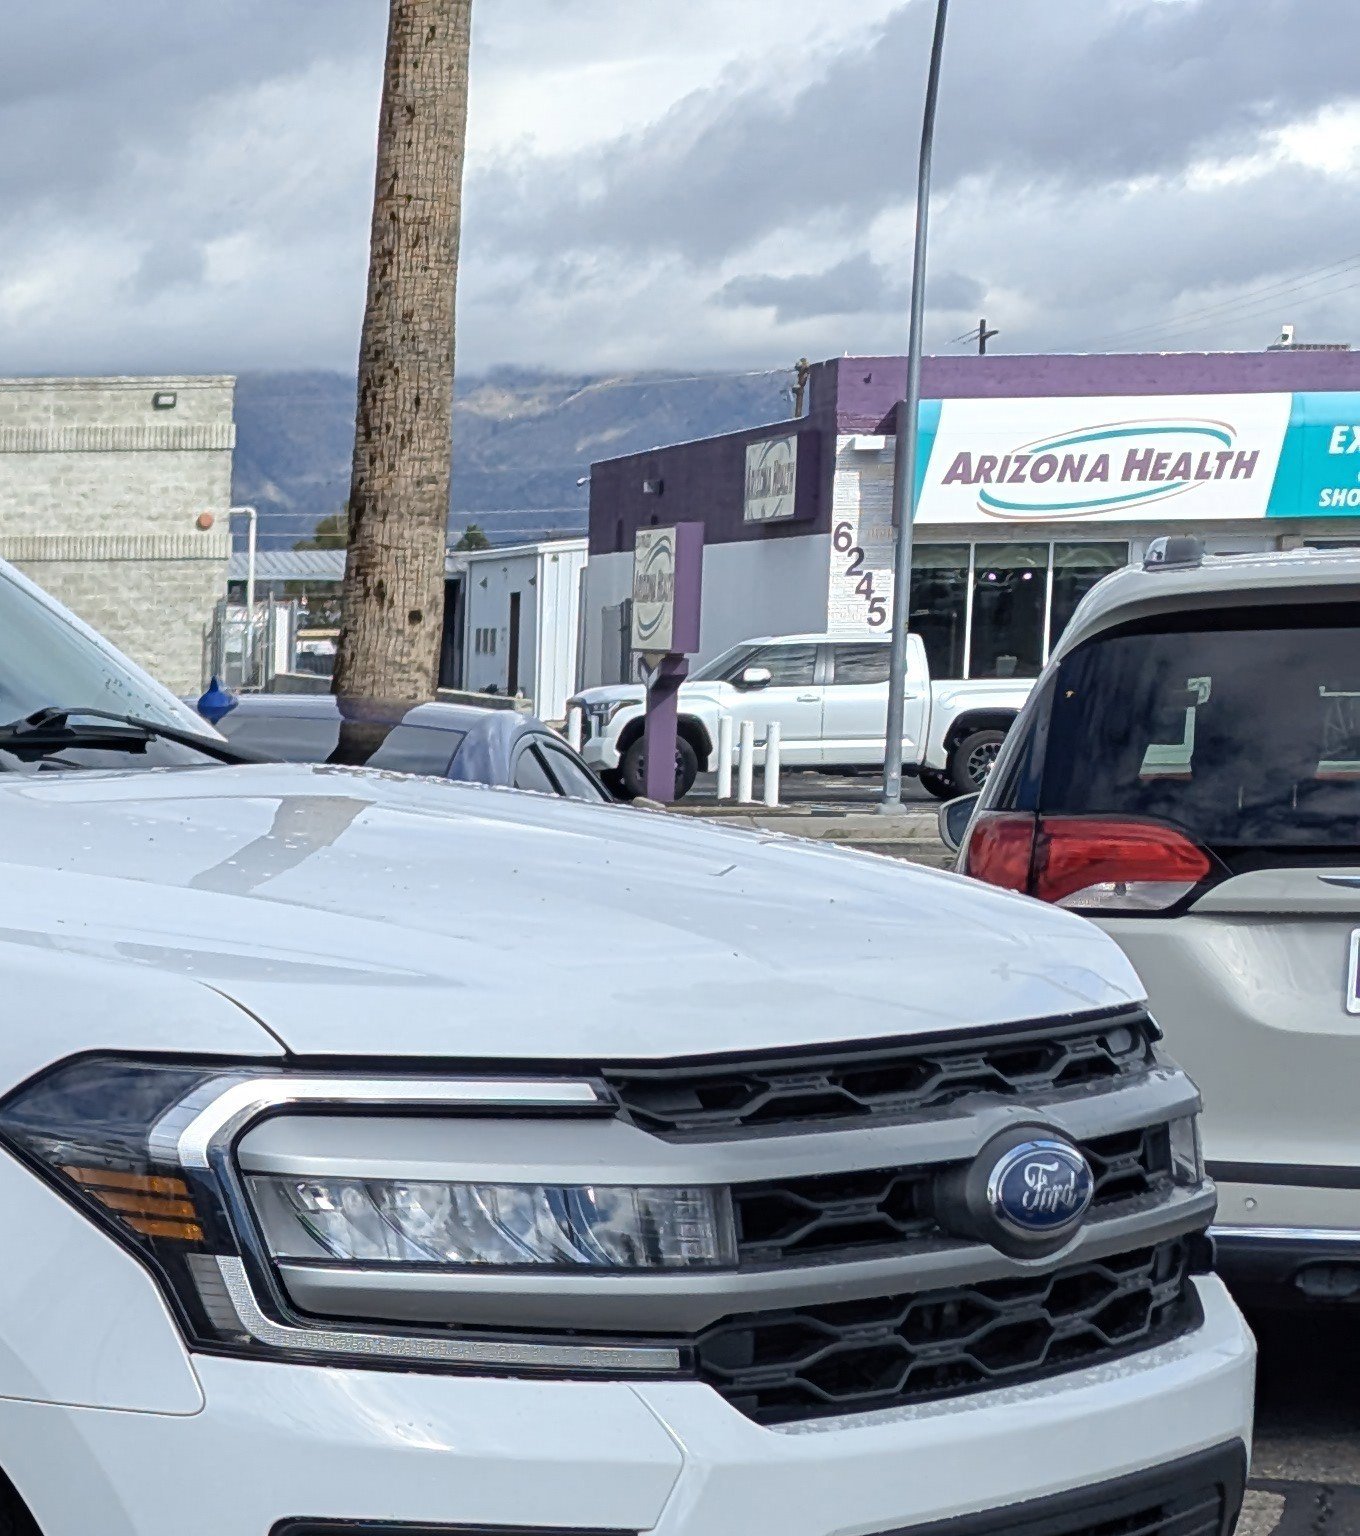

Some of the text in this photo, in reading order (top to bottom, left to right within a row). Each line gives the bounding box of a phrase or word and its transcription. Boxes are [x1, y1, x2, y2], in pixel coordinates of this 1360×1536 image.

[941, 448, 1260, 485] ARIZONA HEALTH
[1022, 1161, 1078, 1214] Ford
